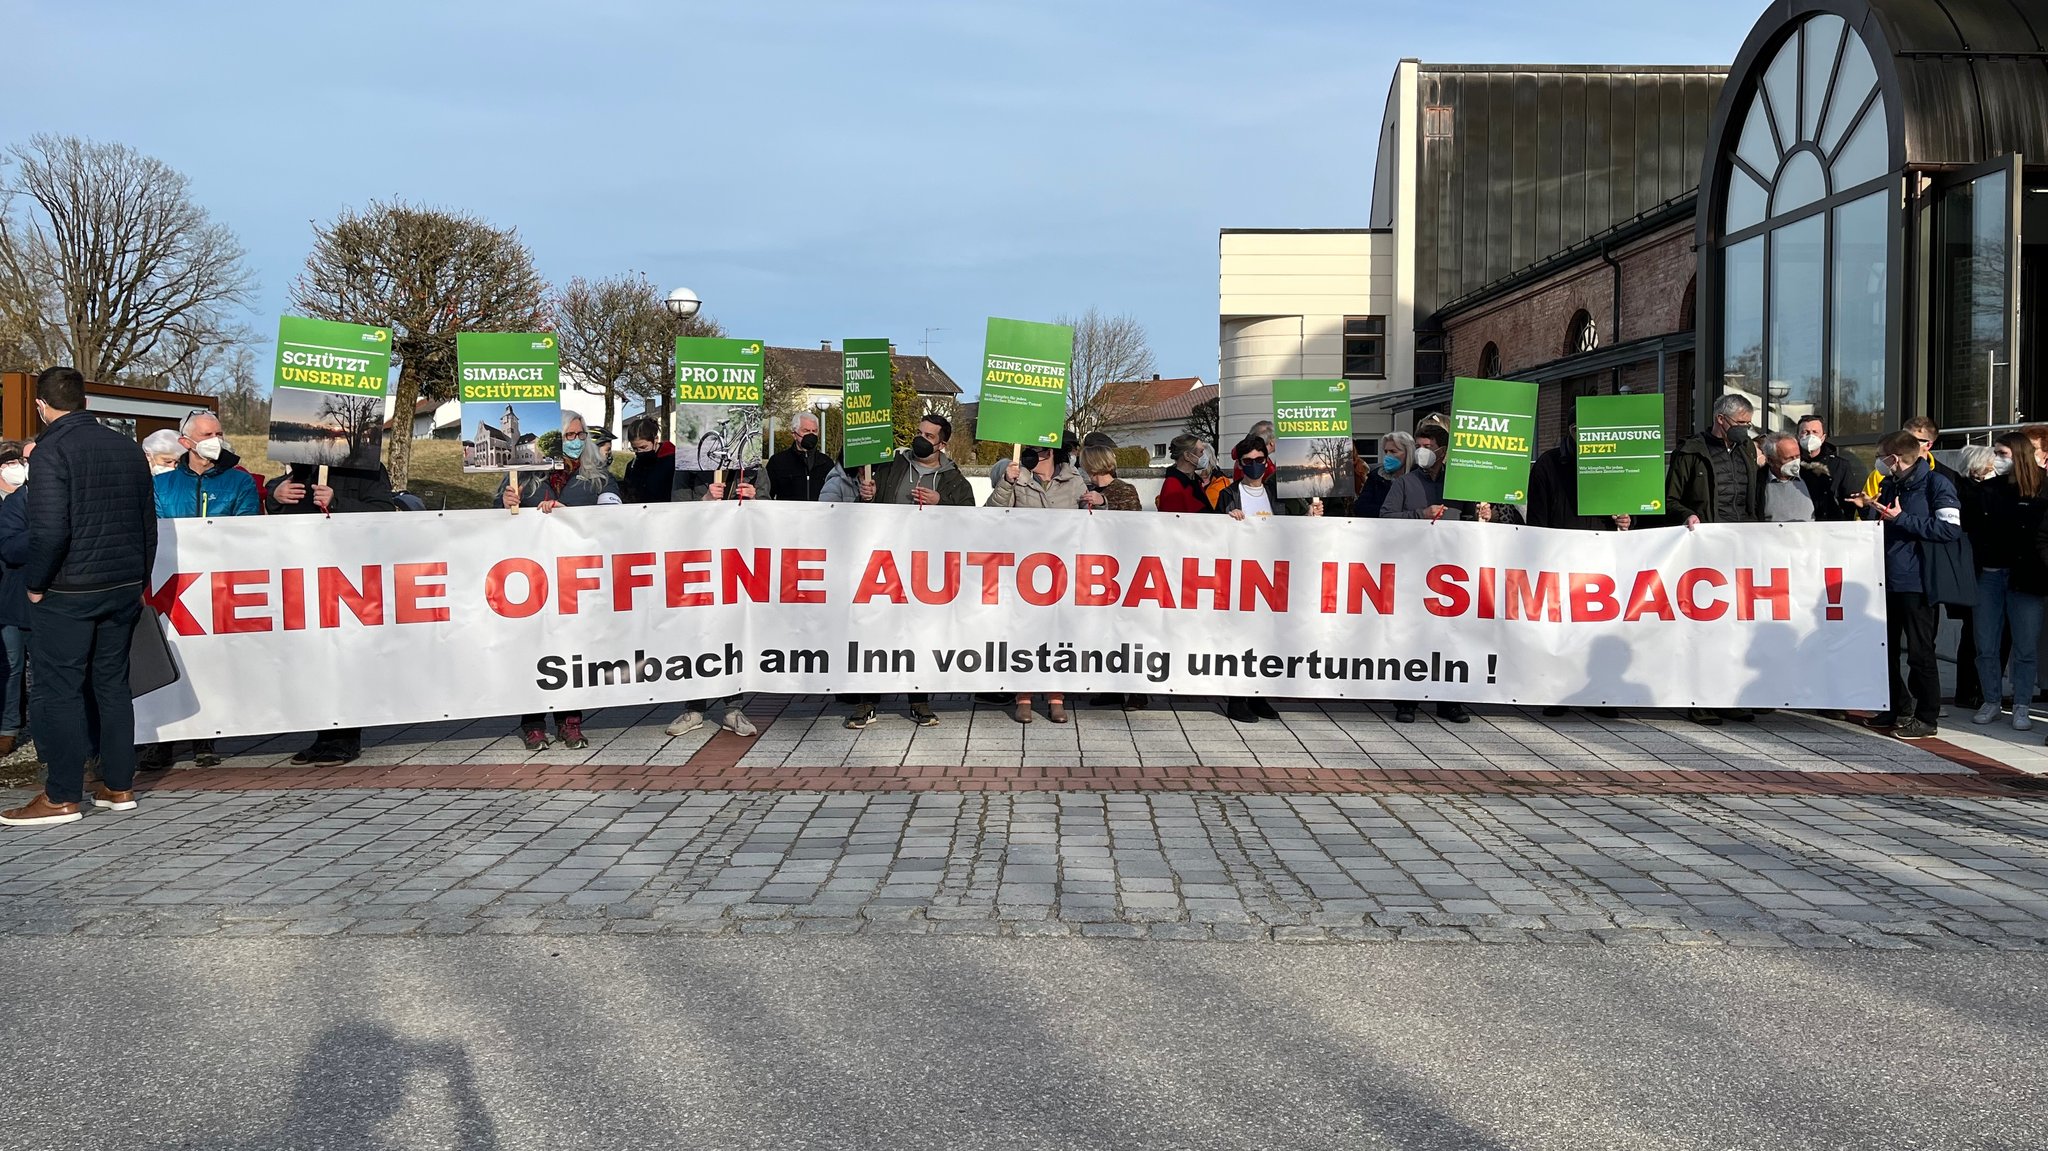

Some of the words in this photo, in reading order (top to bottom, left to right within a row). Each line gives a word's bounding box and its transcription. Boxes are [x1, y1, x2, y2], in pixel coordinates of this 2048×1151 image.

[282, 351, 370, 373] SCHÜTZT
[845, 357, 858, 368] EIN
[987, 359, 1022, 372] KEINE
[1023, 363, 1066, 377] OFFENE
[281, 367, 355, 387] UNSERE
[357, 376, 383, 390] AU
[463, 367, 544, 381] SIMBACH
[681, 367, 719, 383] PRO
[722, 368, 757, 383] INN
[845, 369, 875, 380] TUNNEL
[986, 370, 1065, 390] AUTOBAHN
[464, 382, 556, 399] SCHÜTZEN
[680, 384, 759, 401] RADWEG
[845, 382, 860, 393] FÜR
[845, 395, 872, 409] GANZ
[846, 409, 891, 426] SIMBACH
[1277, 406, 1338, 419] SCHÜTZT
[1278, 420, 1329, 432] UNSERE
[1331, 420, 1348, 432] AU
[1455, 414, 1510, 433] TEAM
[1453, 432, 1529, 452] TUNNEL
[1579, 430, 1662, 442] EINHAUSUNG
[1578, 443, 1617, 455] JETZT!
[143, 561, 451, 637] KEINE
[485, 549, 828, 619] OFFENE
[853, 549, 1290, 613] AUTOBAHN
[1321, 561, 1396, 615] IN
[1423, 563, 1791, 623] SIMBACH
[1823, 567, 1843, 622] !
[536, 643, 743, 691] Simbach
[759, 649, 829, 674] am
[847, 642, 915, 673] Inn
[934, 642, 1170, 683] vollständig
[1188, 649, 1469, 683] untertunneln
[1487, 655, 1498, 684] !
